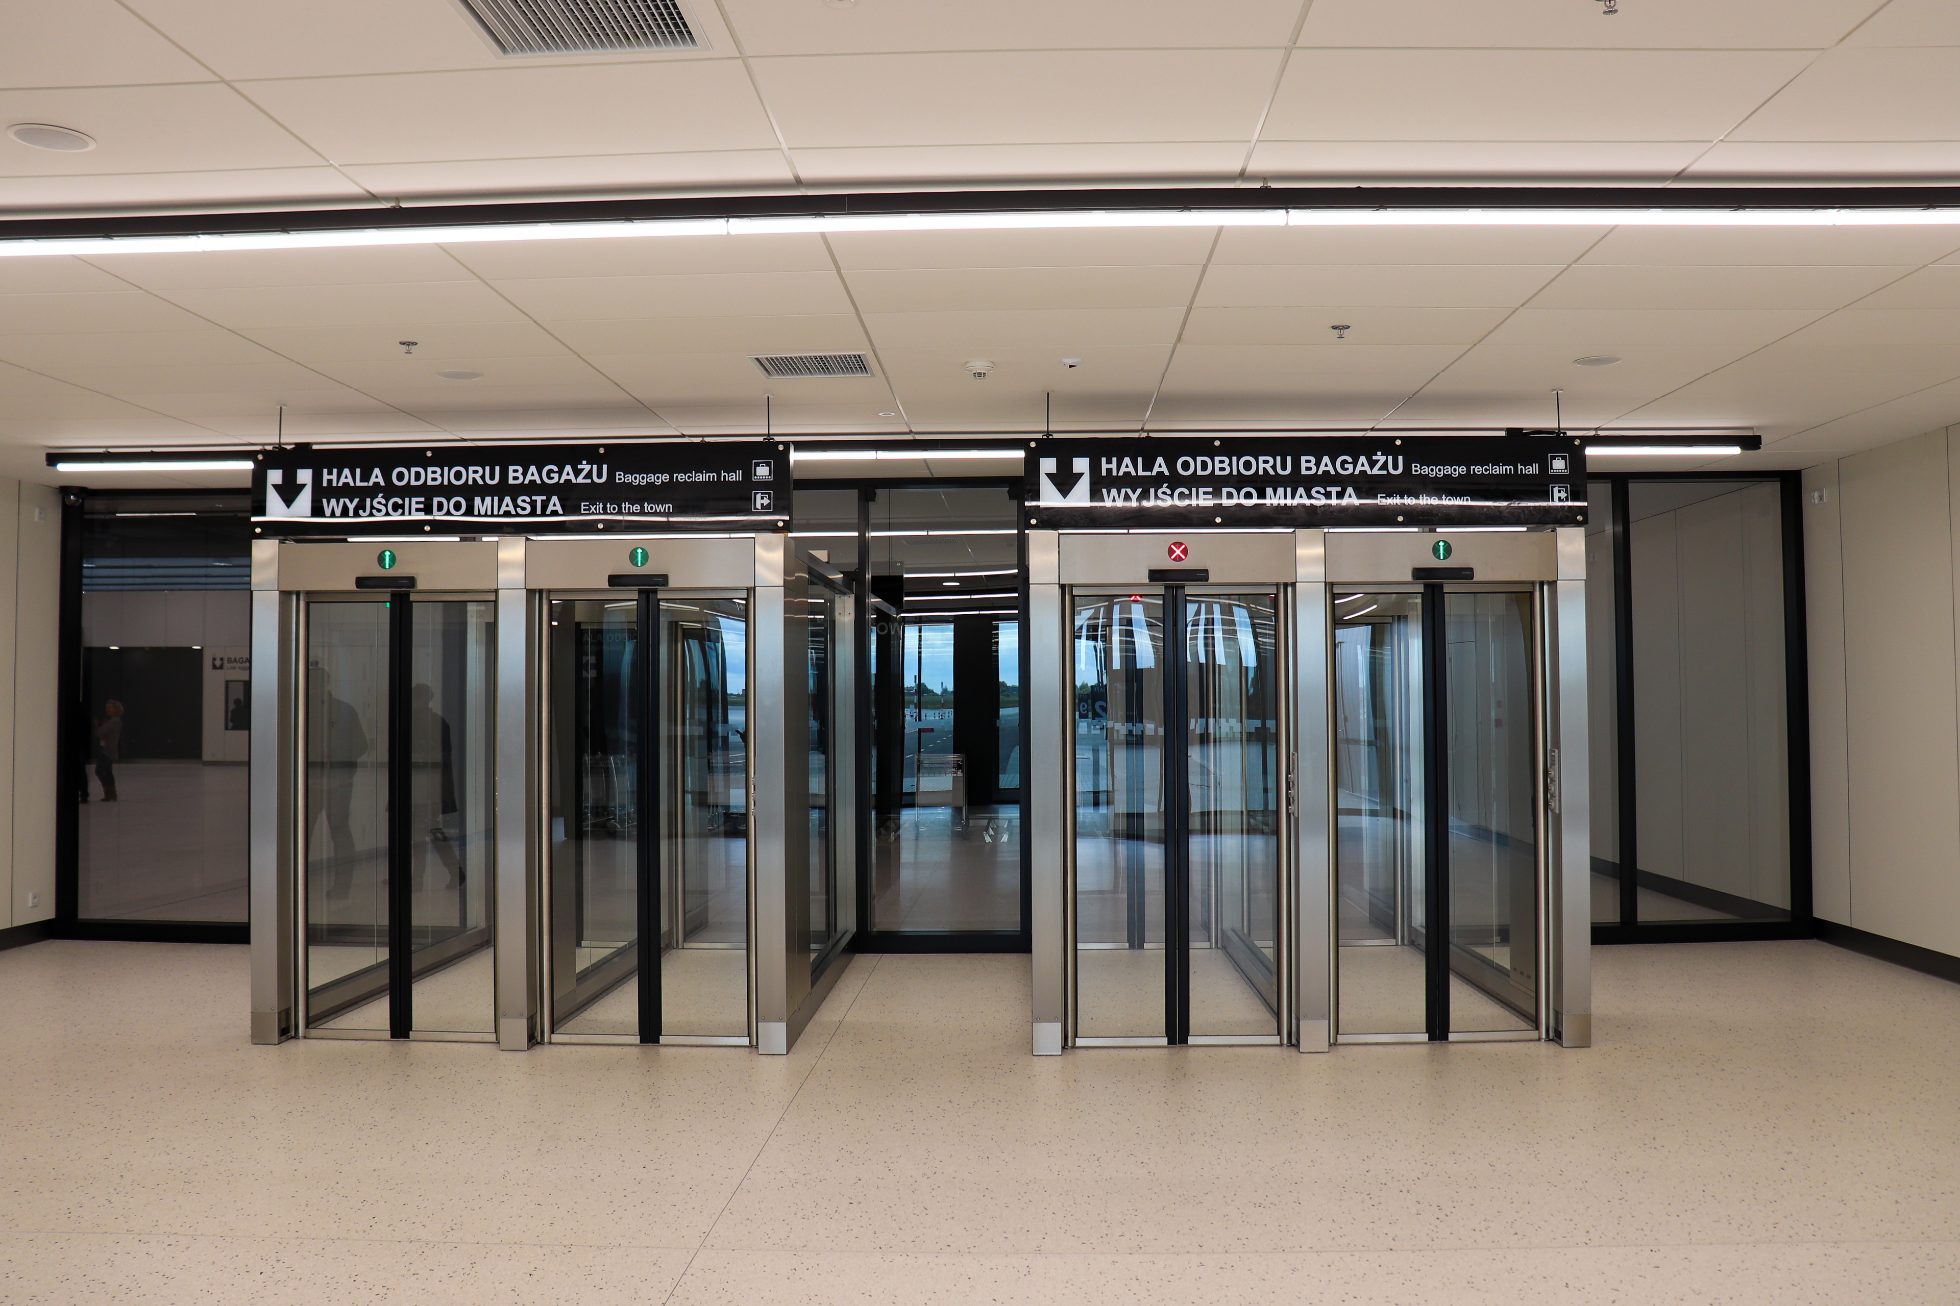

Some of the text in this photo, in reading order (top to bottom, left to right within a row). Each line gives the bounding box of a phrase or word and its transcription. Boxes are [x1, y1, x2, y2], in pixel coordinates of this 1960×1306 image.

[322, 460, 743, 487] HALA ODBIORU BAGAŻU Baggage reclaim hall
[1101, 451, 1539, 478] HALA ODBIORU BAGAŻU Baggage reclaim hall
[322, 493, 673, 517] WYJŚCIE DO MIASTA Exit to the town
[1102, 483, 1471, 507] WYJŚCIE DO MIASTA Exit to the town
